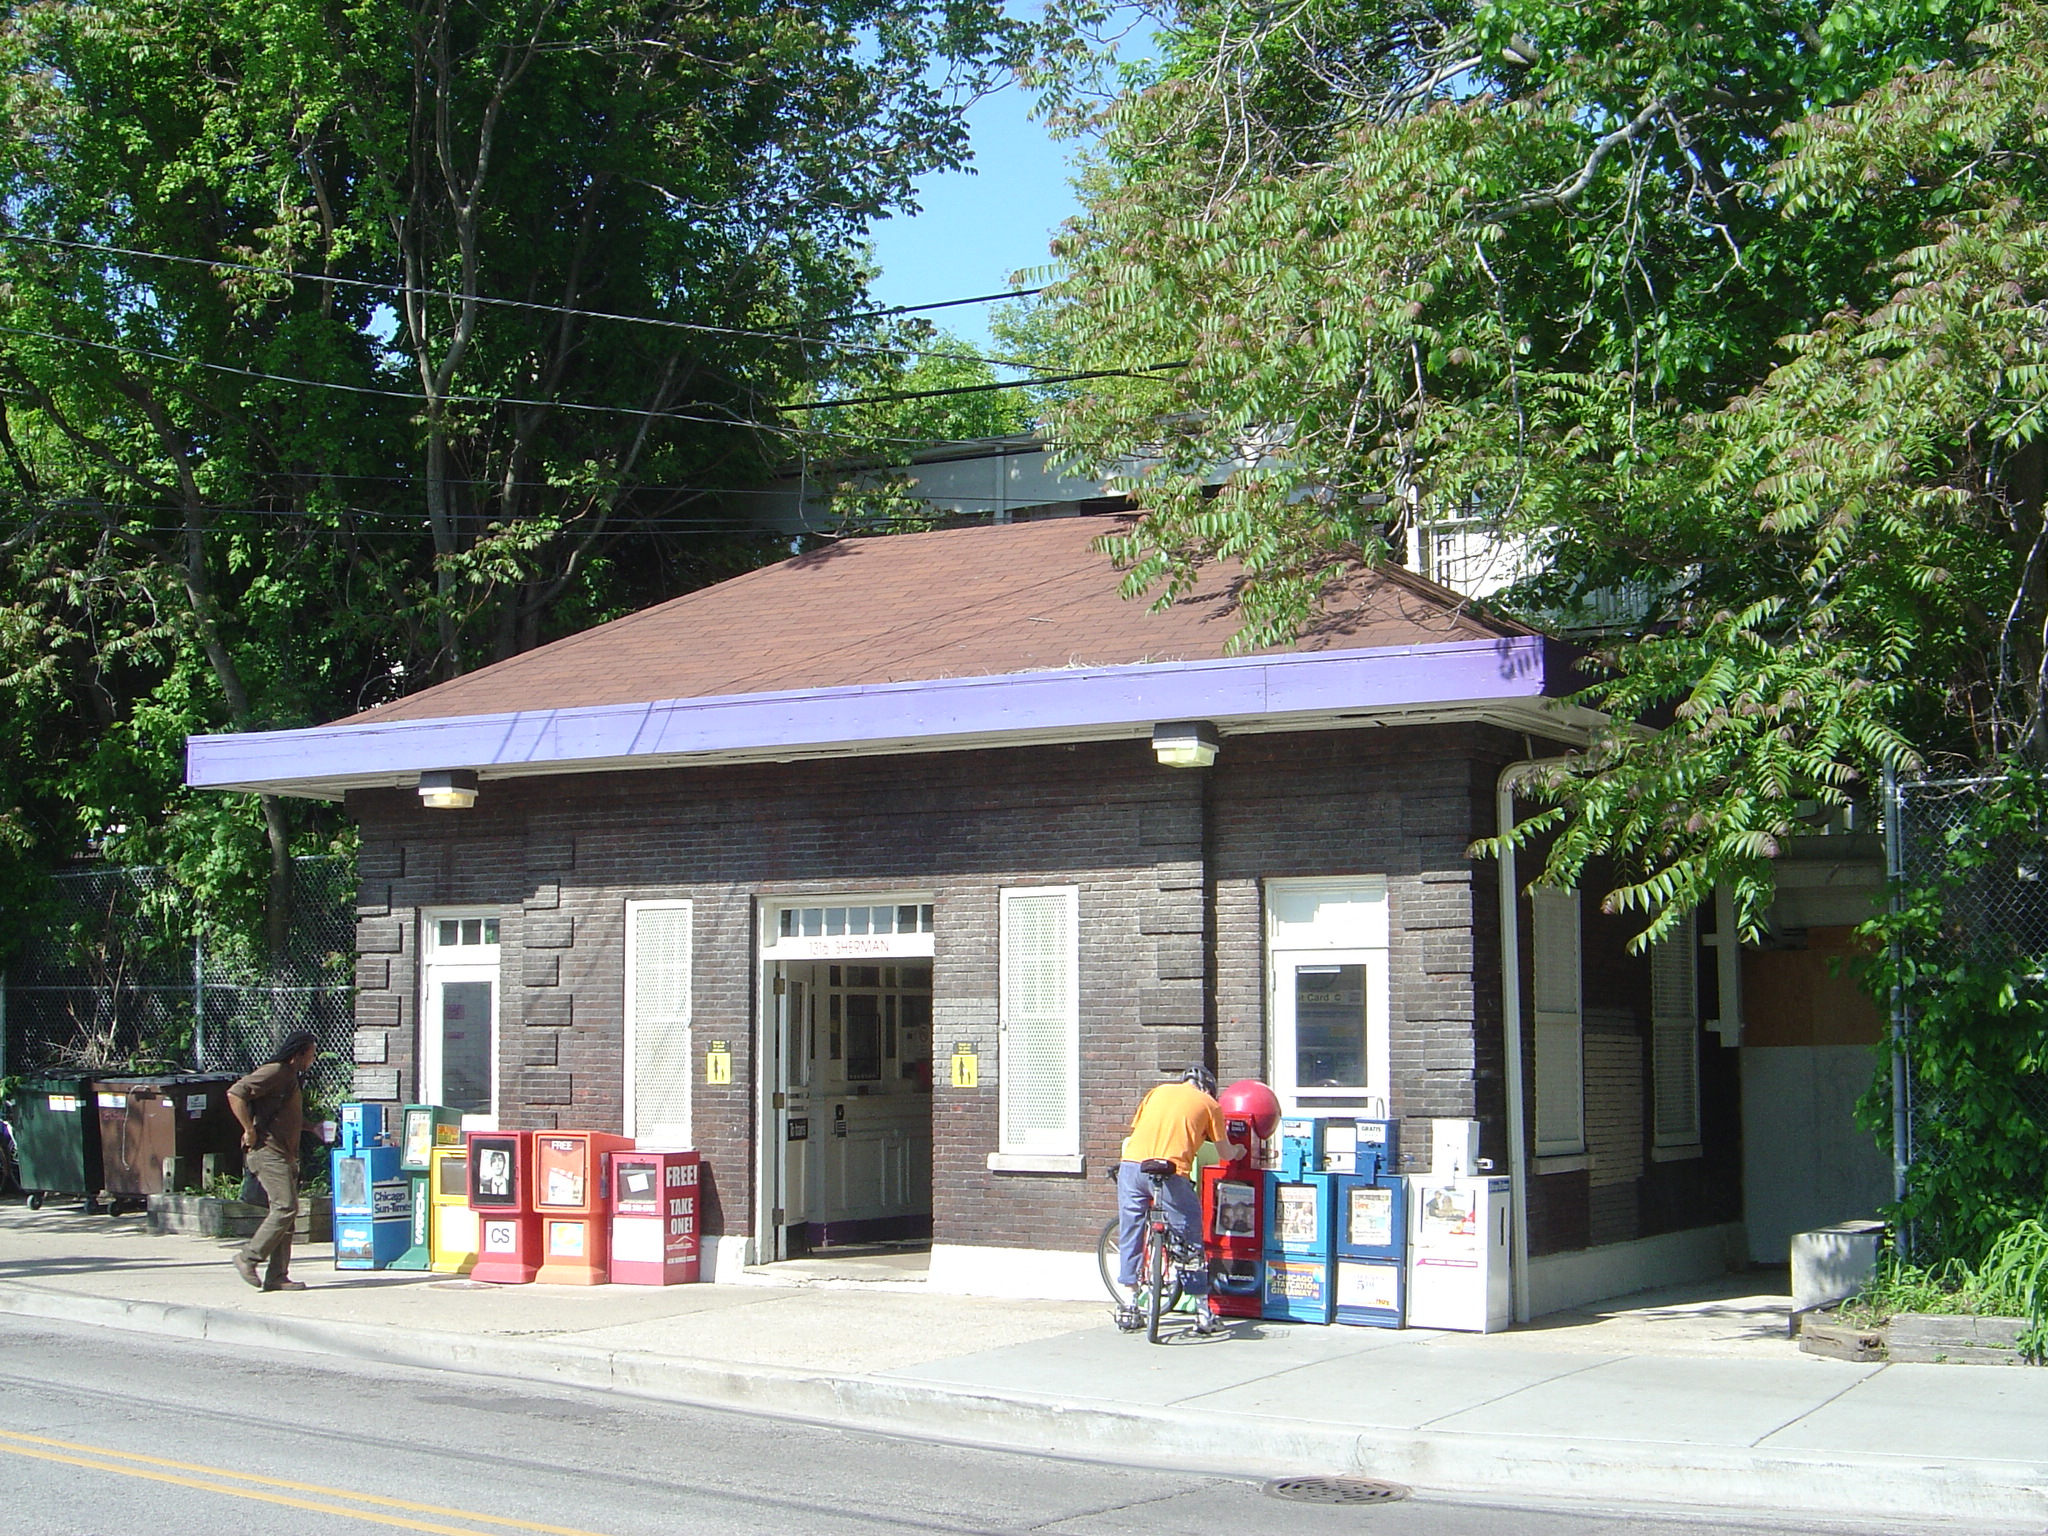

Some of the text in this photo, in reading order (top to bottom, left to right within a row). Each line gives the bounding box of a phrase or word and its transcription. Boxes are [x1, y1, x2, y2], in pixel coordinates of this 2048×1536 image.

[835, 940, 889, 954] SHERMAN
[1307, 993, 1329, 1002] Card
[551, 1140, 573, 1151] FREE
[666, 1165, 698, 1187] FREE!
[373, 1191, 406, 1203] Chicago
[374, 1203, 412, 1214] Sun-Times
[669, 1198, 694, 1216] TAKE
[414, 1182, 425, 1245] JOBS
[671, 1217, 693, 1235] ONE!
[491, 1228, 509, 1244] CS
[1276, 1273, 1314, 1283] CHICAGO
[1271, 1281, 1320, 1290] STAYCATION
[1271, 1287, 1312, 1297] GIVEAWAY
